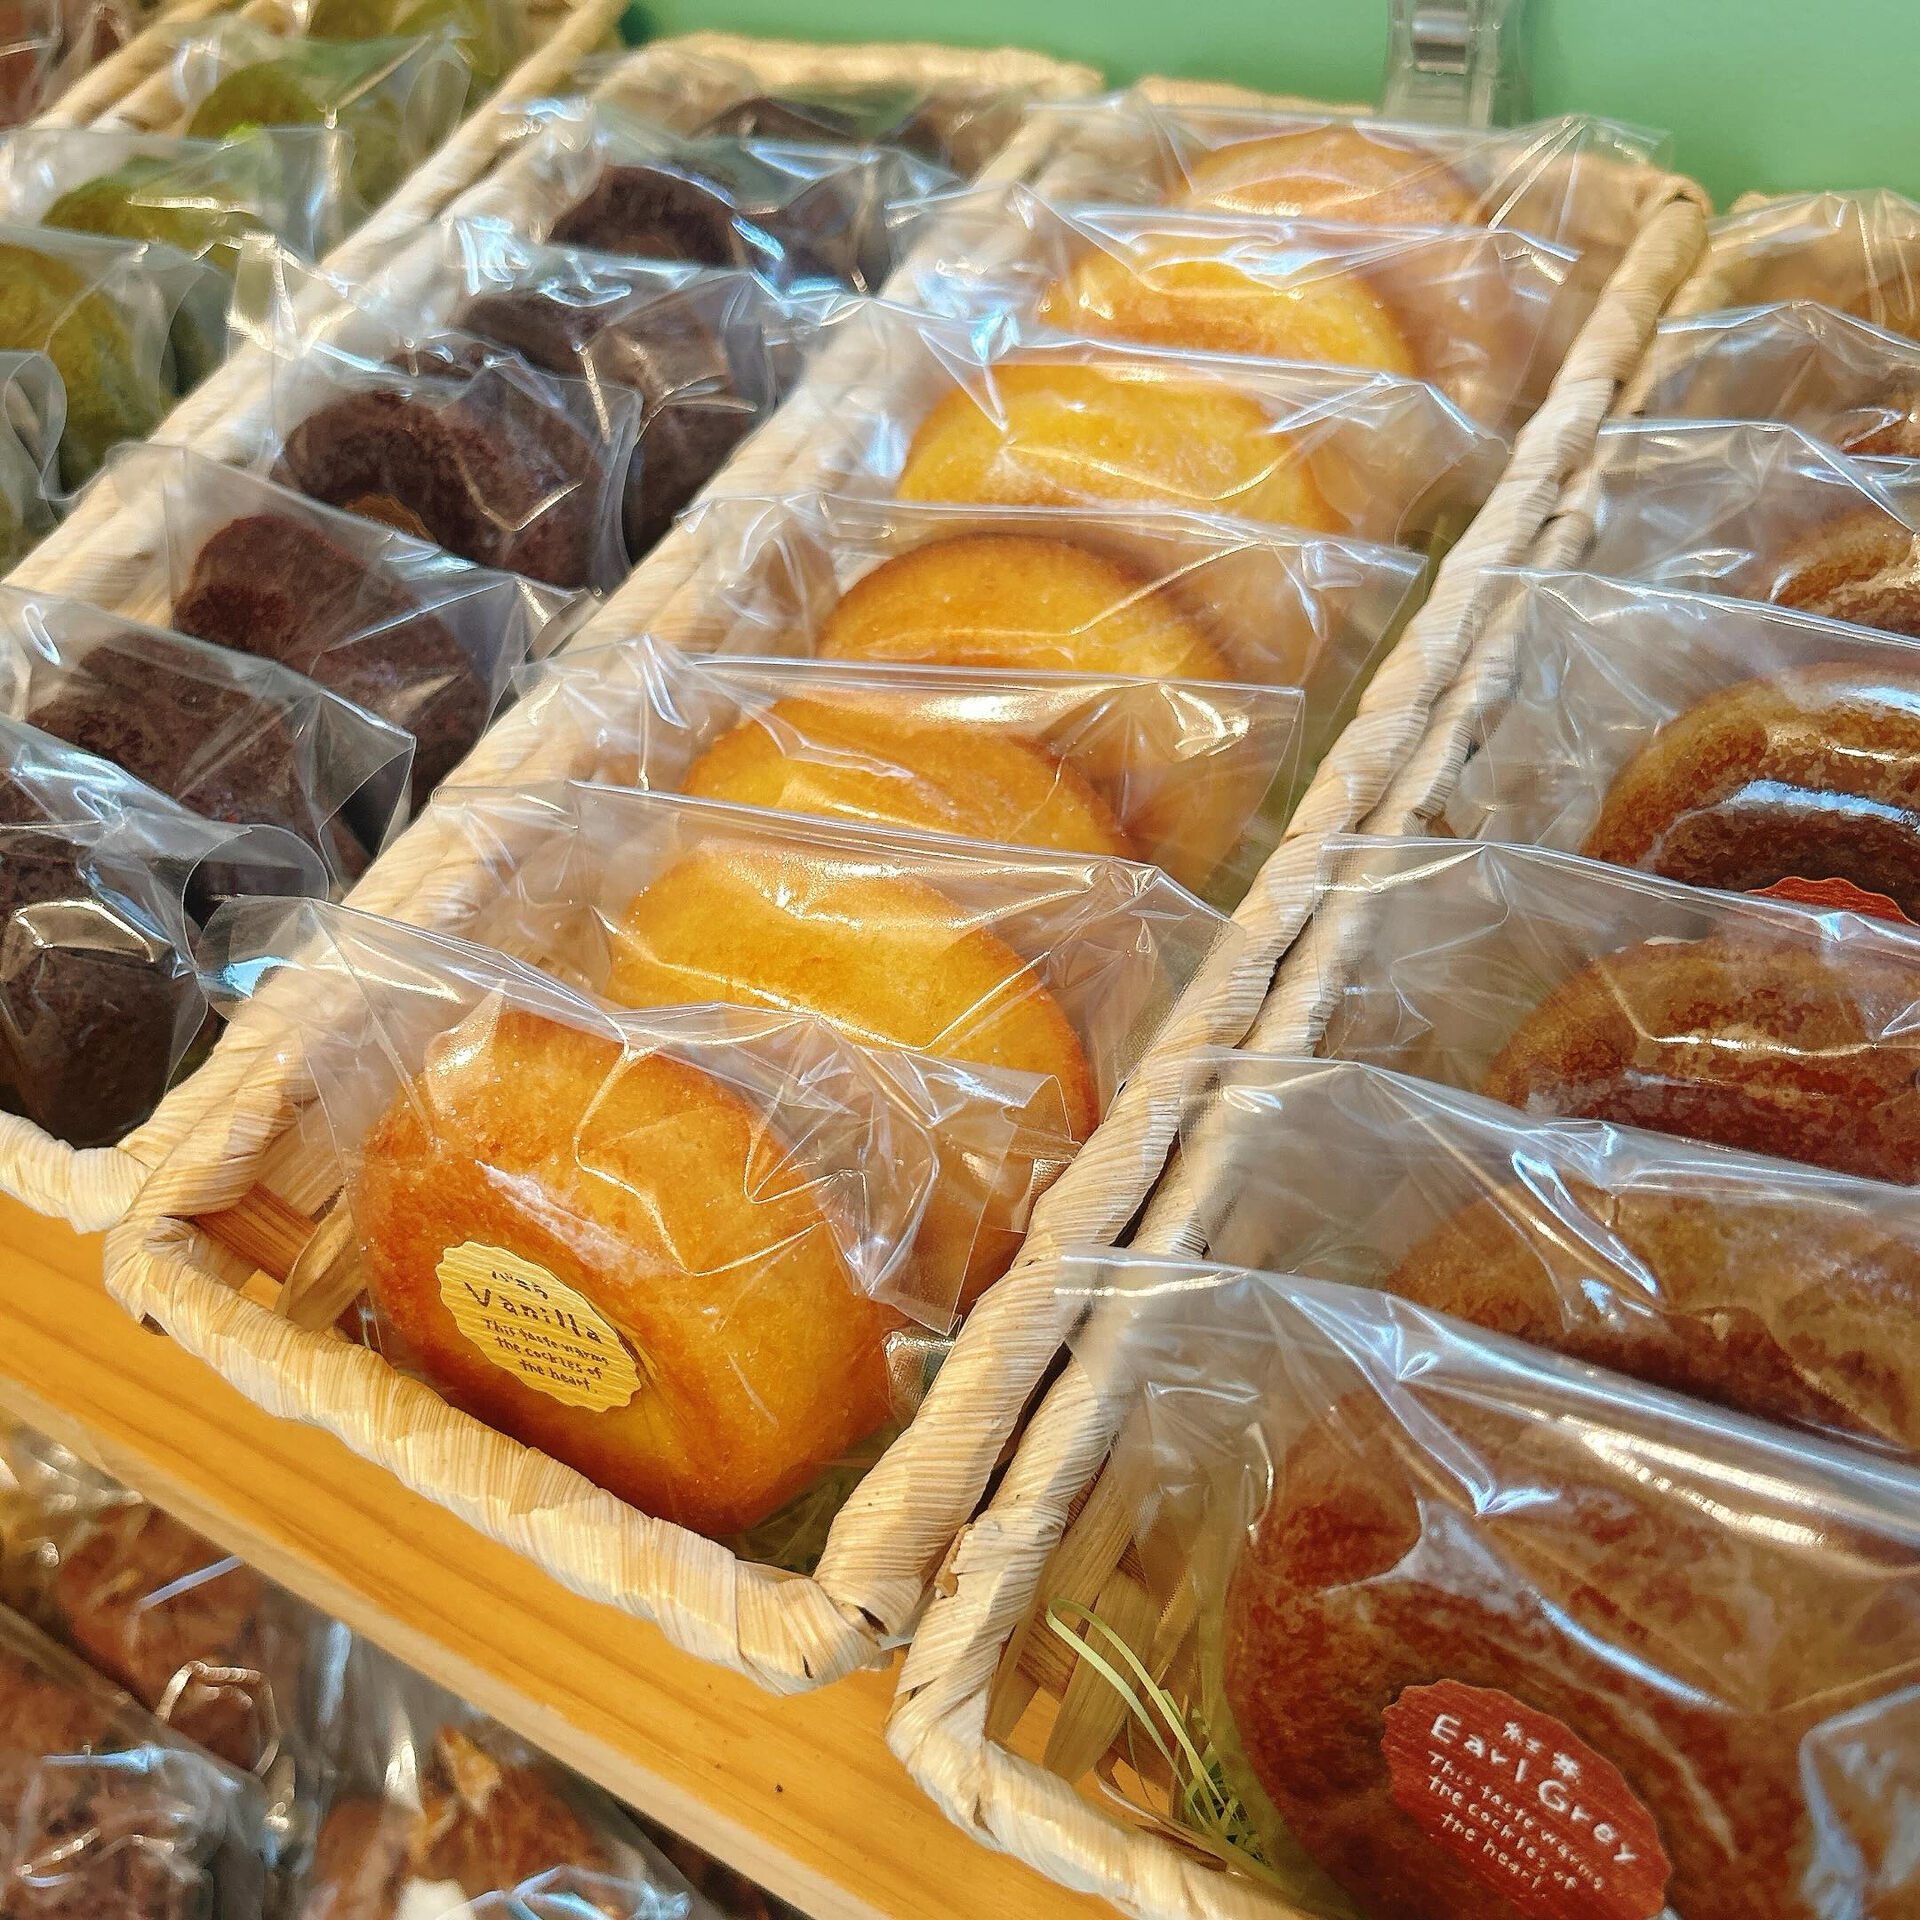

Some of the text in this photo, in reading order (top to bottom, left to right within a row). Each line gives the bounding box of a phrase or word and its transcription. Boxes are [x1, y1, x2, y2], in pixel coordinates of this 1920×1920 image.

[464, 1281, 602, 1344] Vanilla
[482, 1317, 609, 1366] This taste warms
[495, 1336, 603, 1380] the cockles of
[519, 1359, 546, 1376] the
[1428, 1750, 1474, 1786] This
[1480, 1785, 1536, 1830] taste
[1467, 1803, 1548, 1869] cockles
